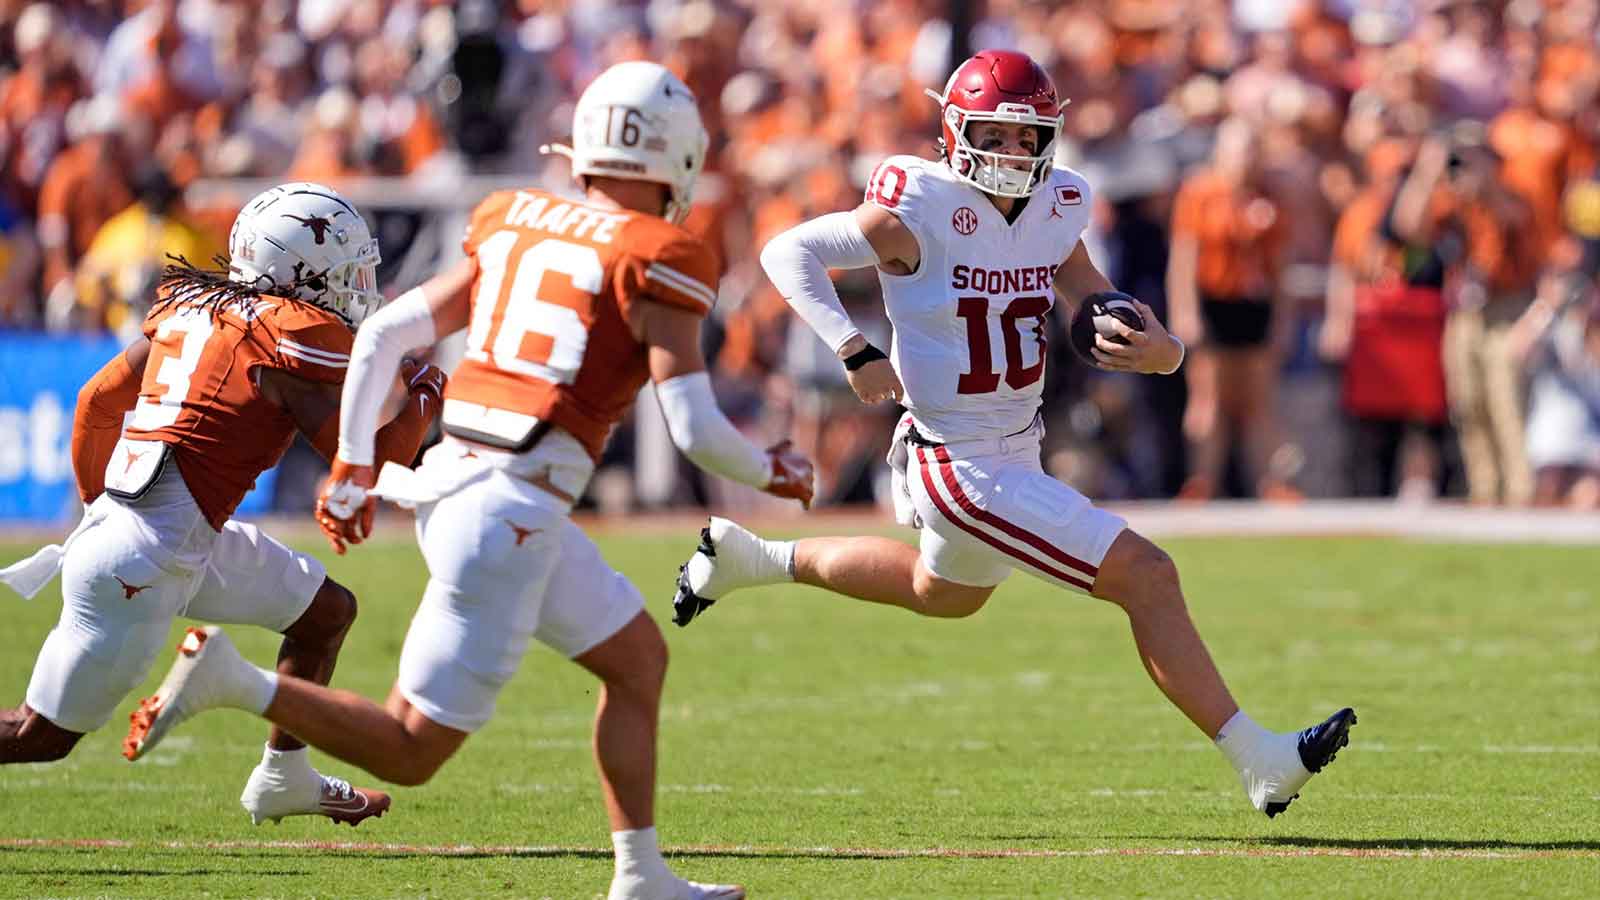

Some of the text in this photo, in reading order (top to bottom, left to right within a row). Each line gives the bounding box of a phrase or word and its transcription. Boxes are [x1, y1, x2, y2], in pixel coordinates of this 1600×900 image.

[605, 105, 640, 147] 16
[866, 163, 907, 208] 10
[505, 191, 631, 244] TAAFFE
[954, 208, 977, 234] SEC
[464, 230, 604, 385] 16
[957, 296, 1051, 395] 10
[122, 305, 215, 440] 3
